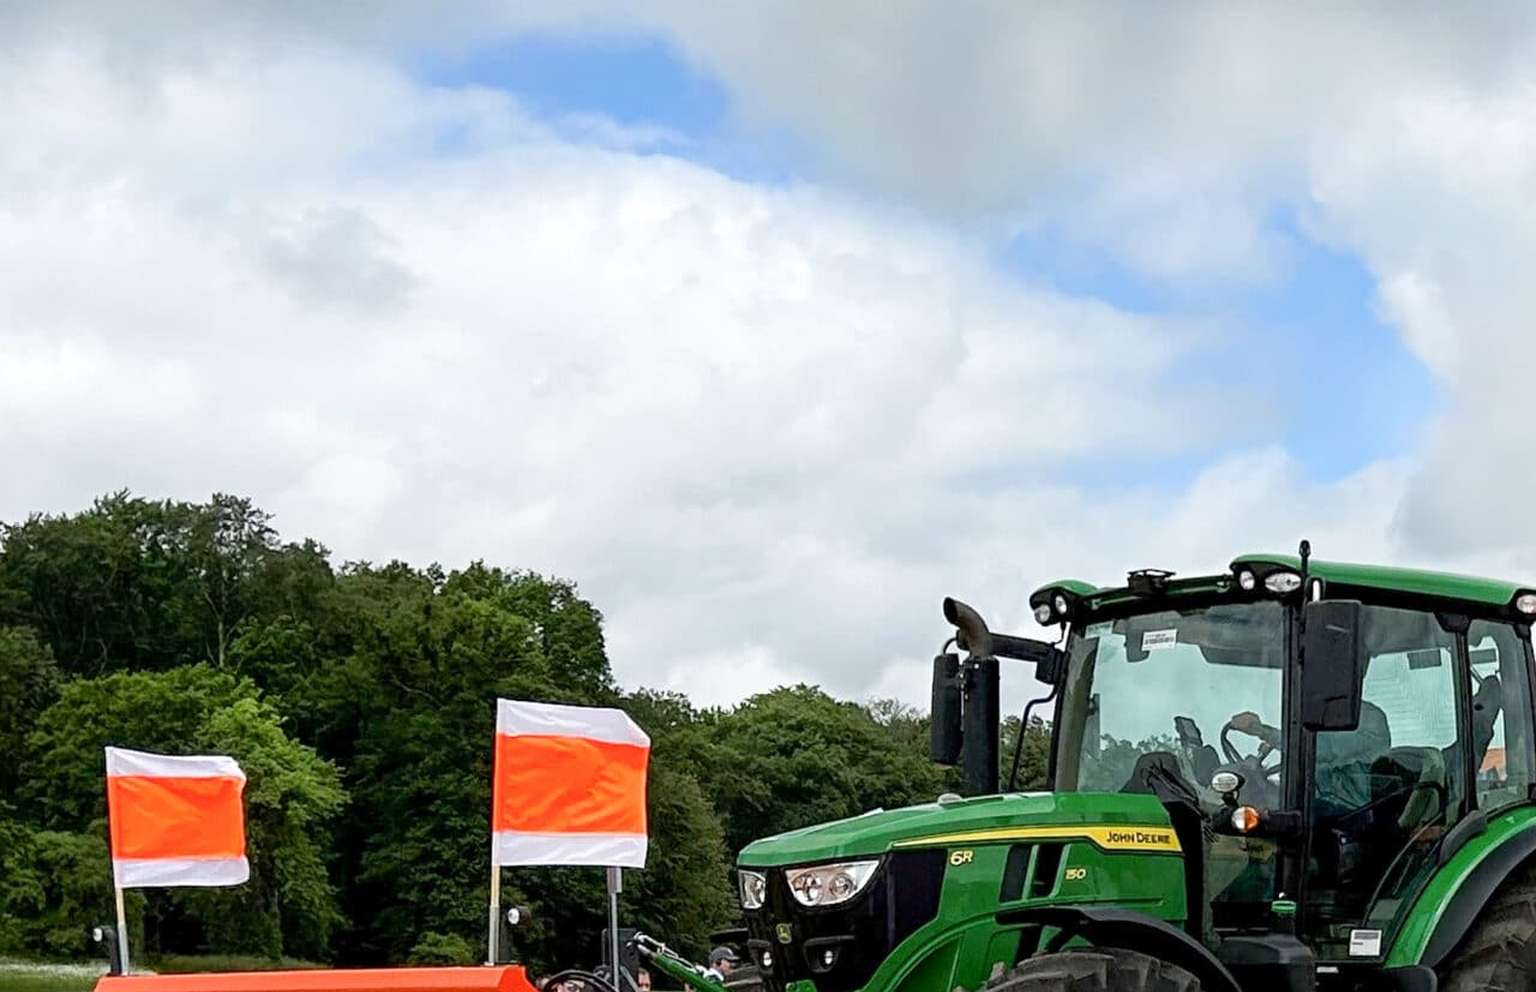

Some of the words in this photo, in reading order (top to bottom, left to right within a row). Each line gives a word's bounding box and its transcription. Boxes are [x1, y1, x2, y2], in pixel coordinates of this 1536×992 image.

[1106, 831, 1135, 843] JOHN
[1136, 832, 1171, 844] DEERE
[950, 850, 974, 866] 6R
[1064, 868, 1087, 880] 150
